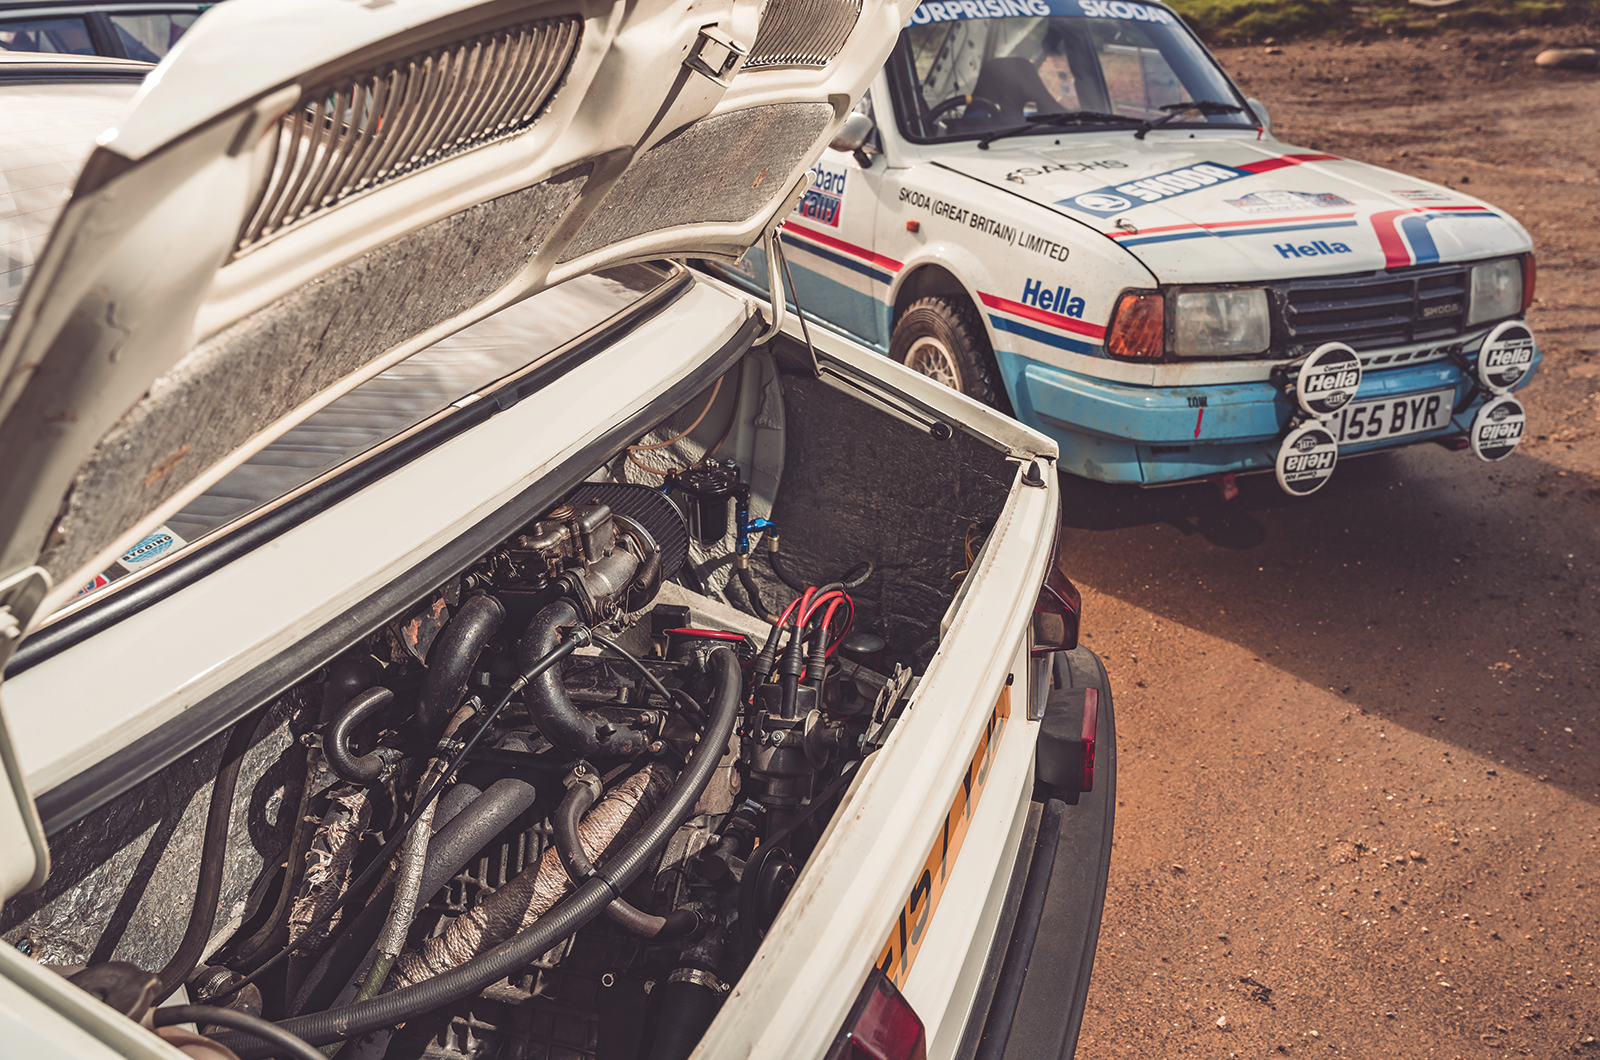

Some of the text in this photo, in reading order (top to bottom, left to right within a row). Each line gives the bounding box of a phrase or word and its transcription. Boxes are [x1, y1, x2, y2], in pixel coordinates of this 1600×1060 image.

[904, 0, 1050, 28] URPRISING
[811, 163, 847, 195] bard
[1016, 160, 1128, 177] SACHS
[1115, 164, 1239, 202] SKODA
[899, 187, 1070, 262] SKODA (GREAT BRITAIN) LIMITED
[1273, 240, 1353, 259] Hella
[1021, 278, 1086, 318] Hella
[1423, 303, 1458, 317] SKODA
[1488, 348, 1531, 366] Hella
[1306, 370, 1358, 393] Hella
[1325, 395, 1441, 442] 155 BYR
[1480, 422, 1522, 440] Hella
[1286, 451, 1333, 472] Hella
